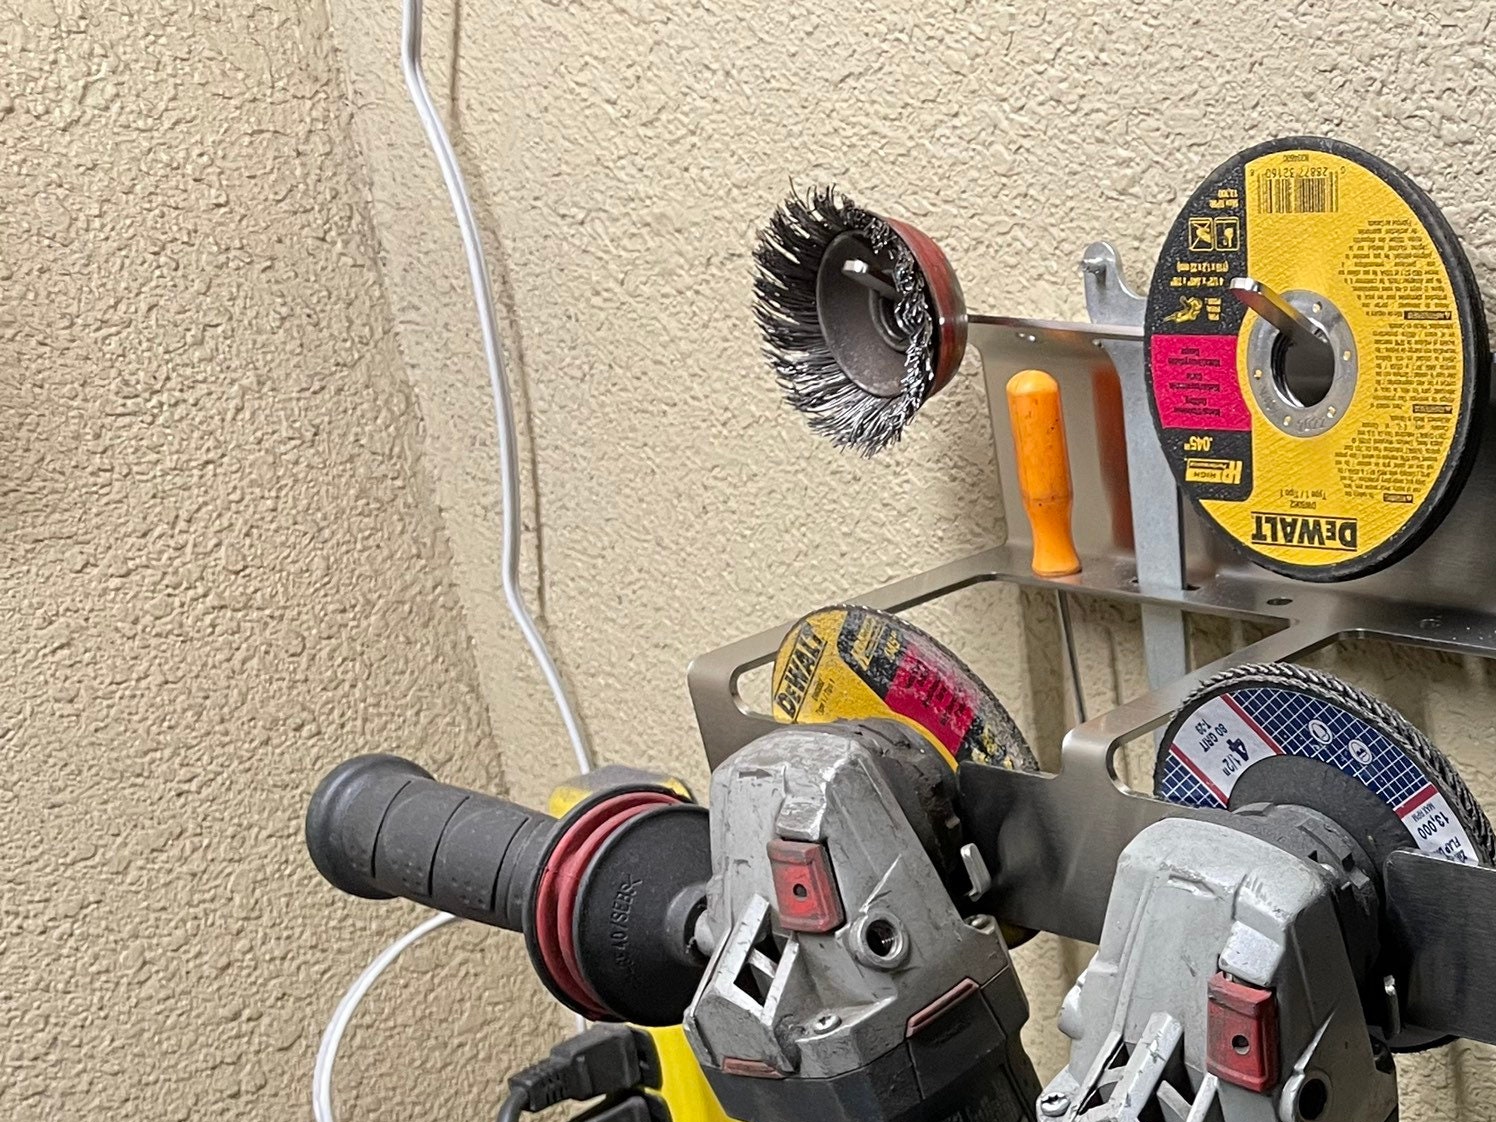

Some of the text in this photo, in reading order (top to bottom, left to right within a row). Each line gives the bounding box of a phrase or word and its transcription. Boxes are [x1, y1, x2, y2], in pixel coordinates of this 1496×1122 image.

[1251, 517, 1358, 548] DEWALT
[1199, 723, 1228, 752] 80 GRIT
[1226, 737, 1250, 762] 4
[1416, 811, 1450, 840] 13,000
